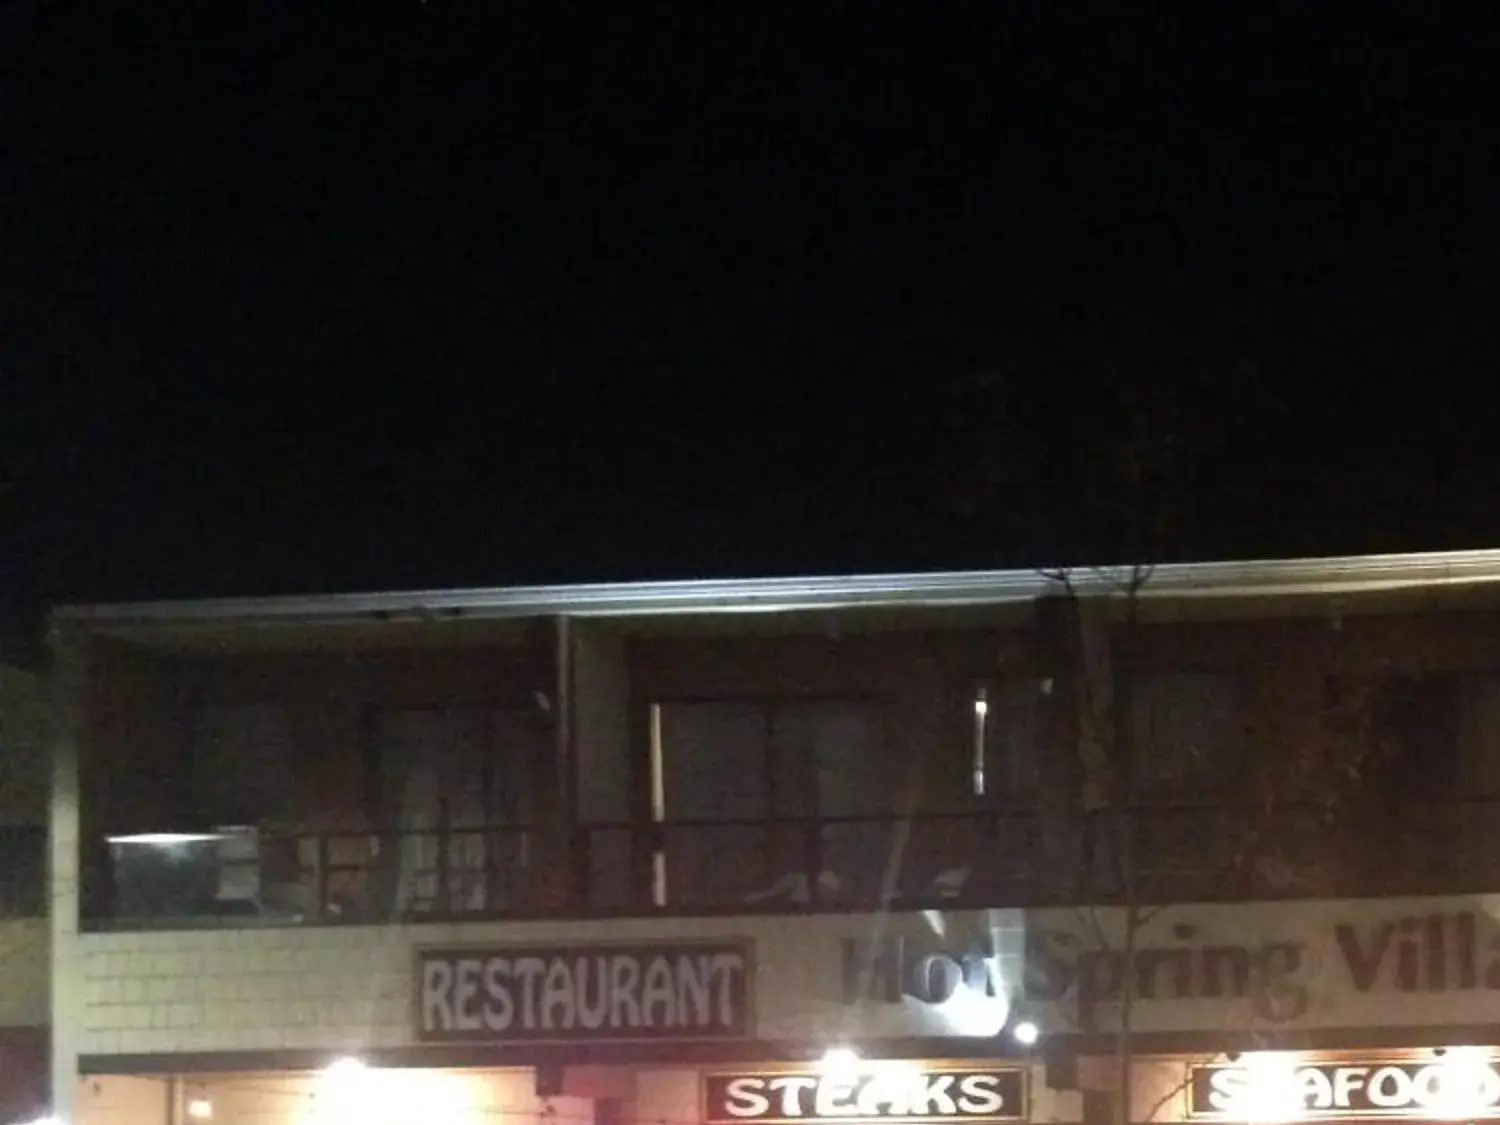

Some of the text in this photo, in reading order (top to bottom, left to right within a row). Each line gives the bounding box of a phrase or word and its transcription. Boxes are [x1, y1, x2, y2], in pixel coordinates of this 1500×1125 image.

[422, 954, 744, 1031] RESTAURANT
[1024, 920, 1307, 1034] Spring
[725, 1073, 1003, 1117] STEAKS
